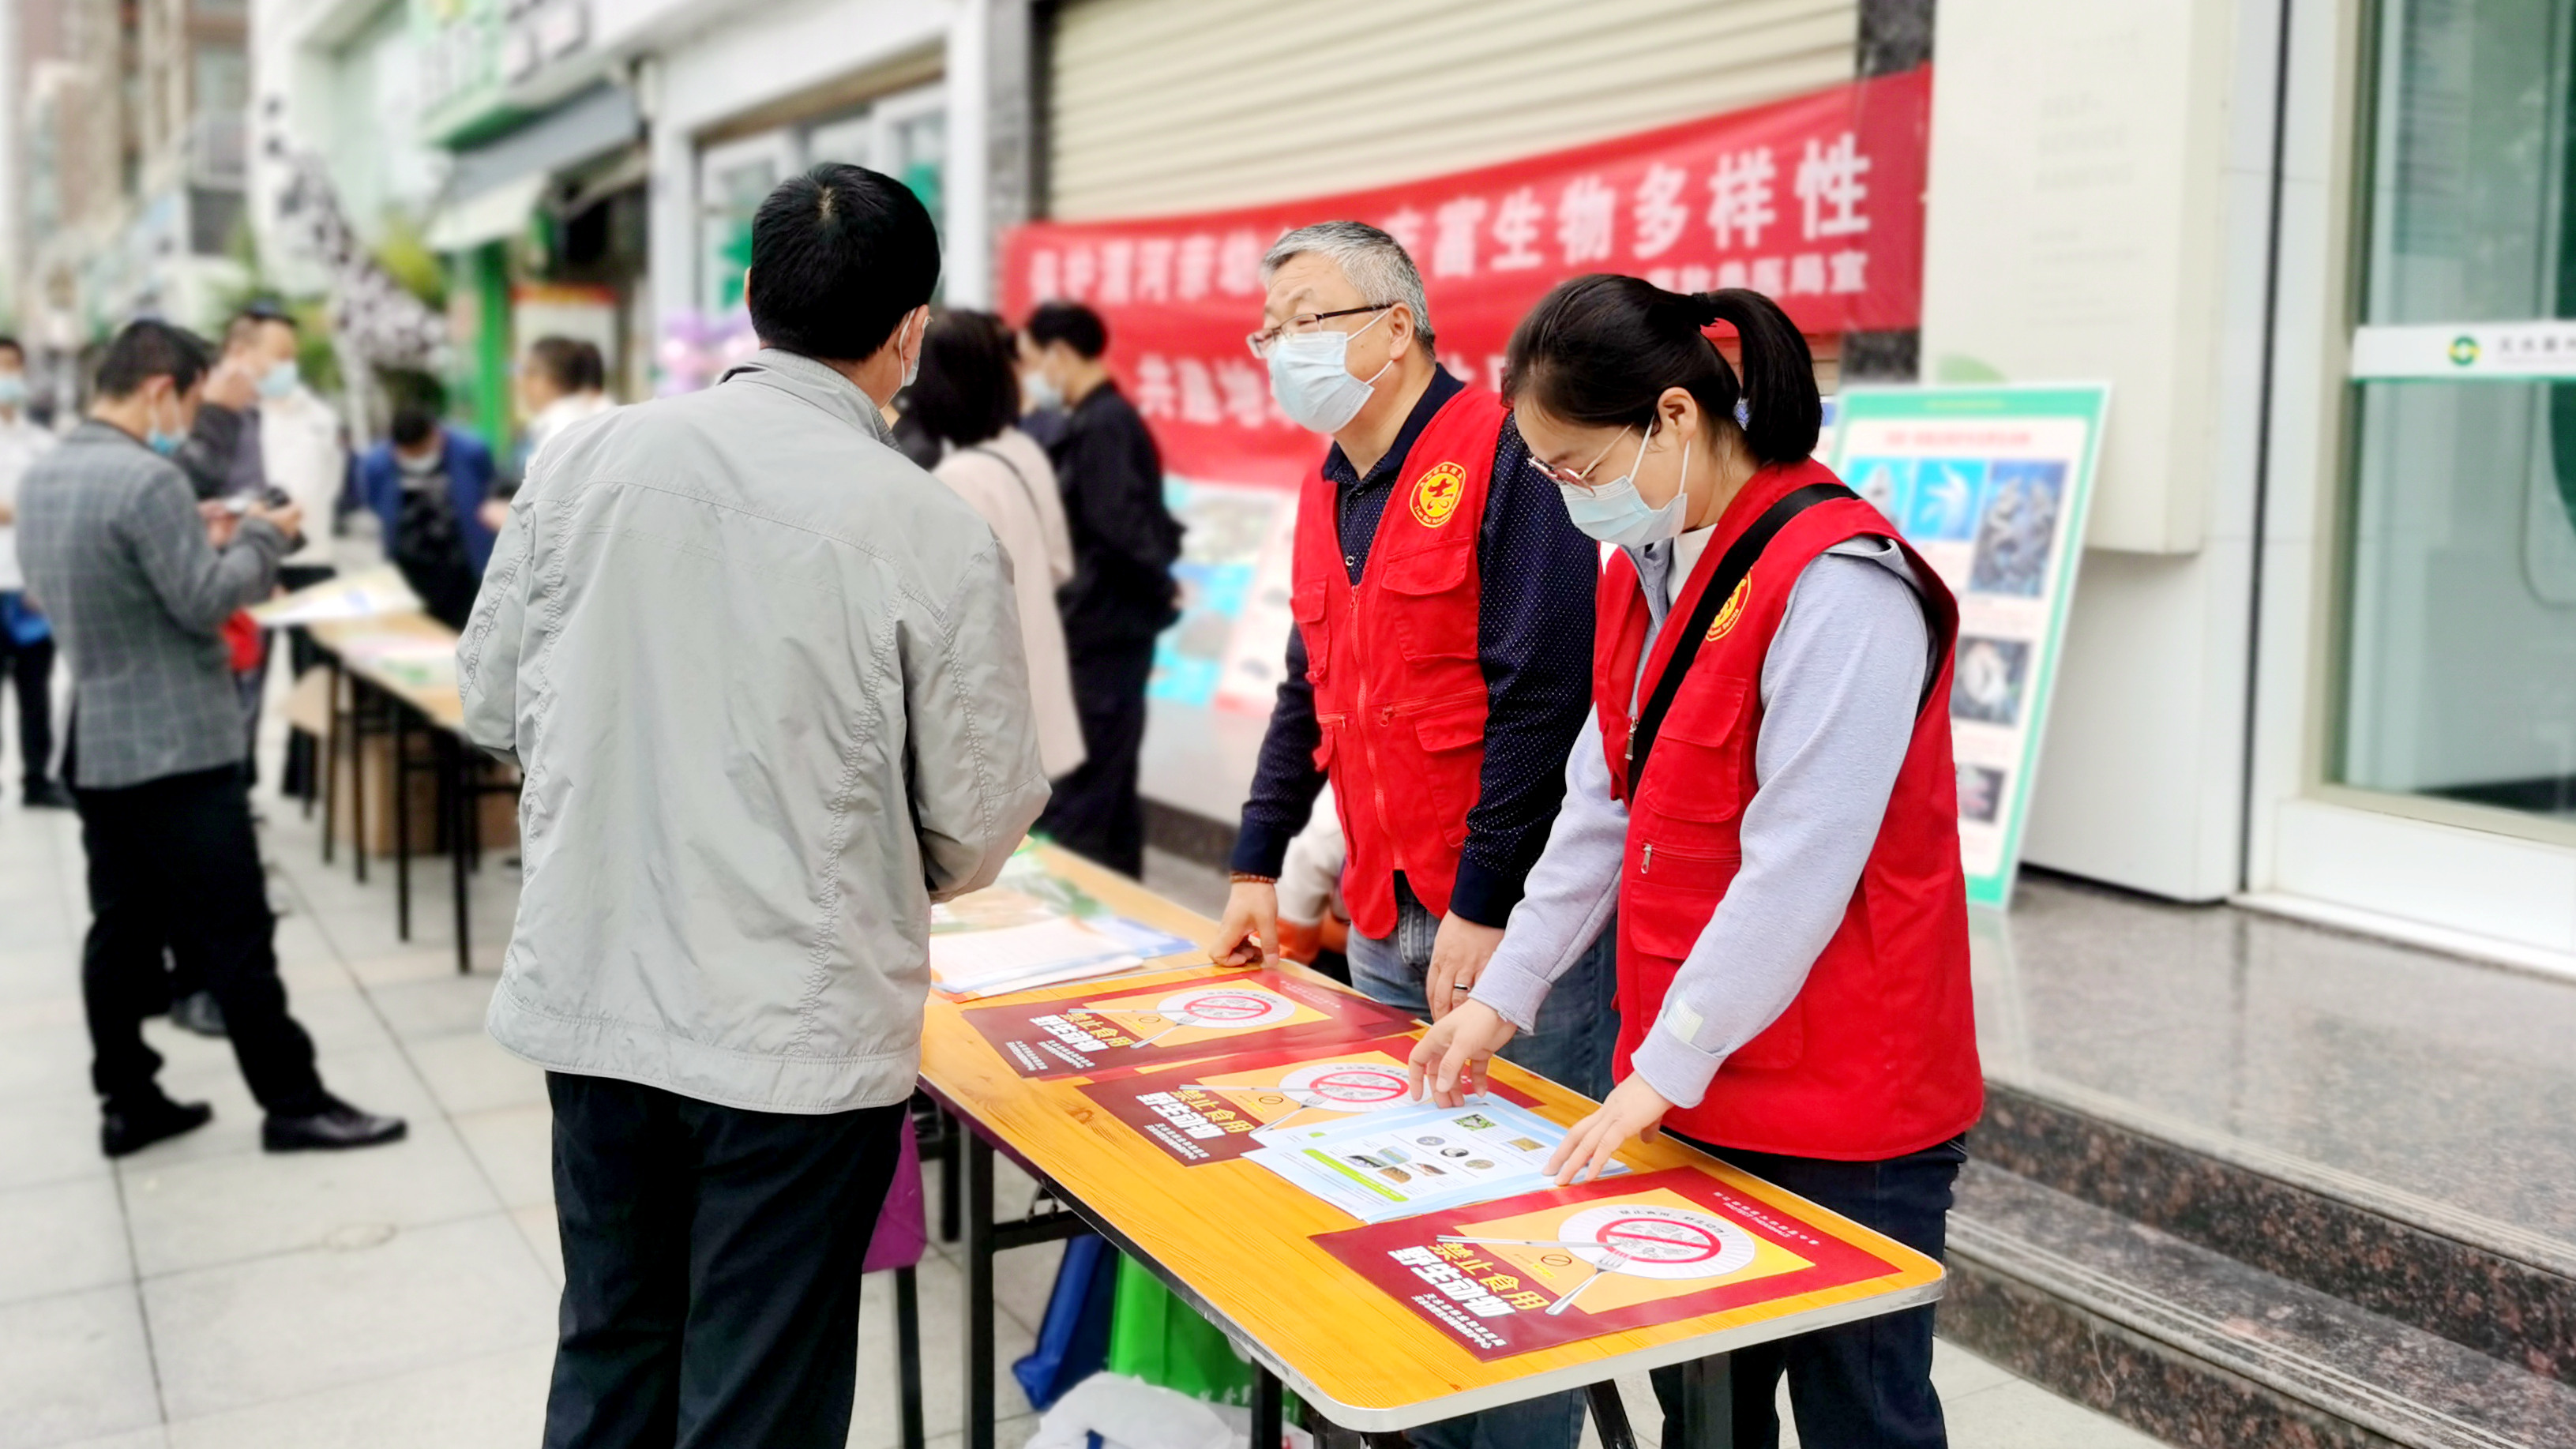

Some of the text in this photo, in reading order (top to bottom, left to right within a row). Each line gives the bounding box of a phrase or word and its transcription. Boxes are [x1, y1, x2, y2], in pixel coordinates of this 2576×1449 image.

[1029, 1015, 1110, 1053] 野生动物
[1059, 1012, 1136, 1047] 禁止食用
[1136, 1091, 1226, 1139] 野生动物
[1170, 1090, 1256, 1133] 禁止食用
[1387, 1245, 1517, 1318] 野生动物
[1427, 1242, 1551, 1310] 禁止食用
